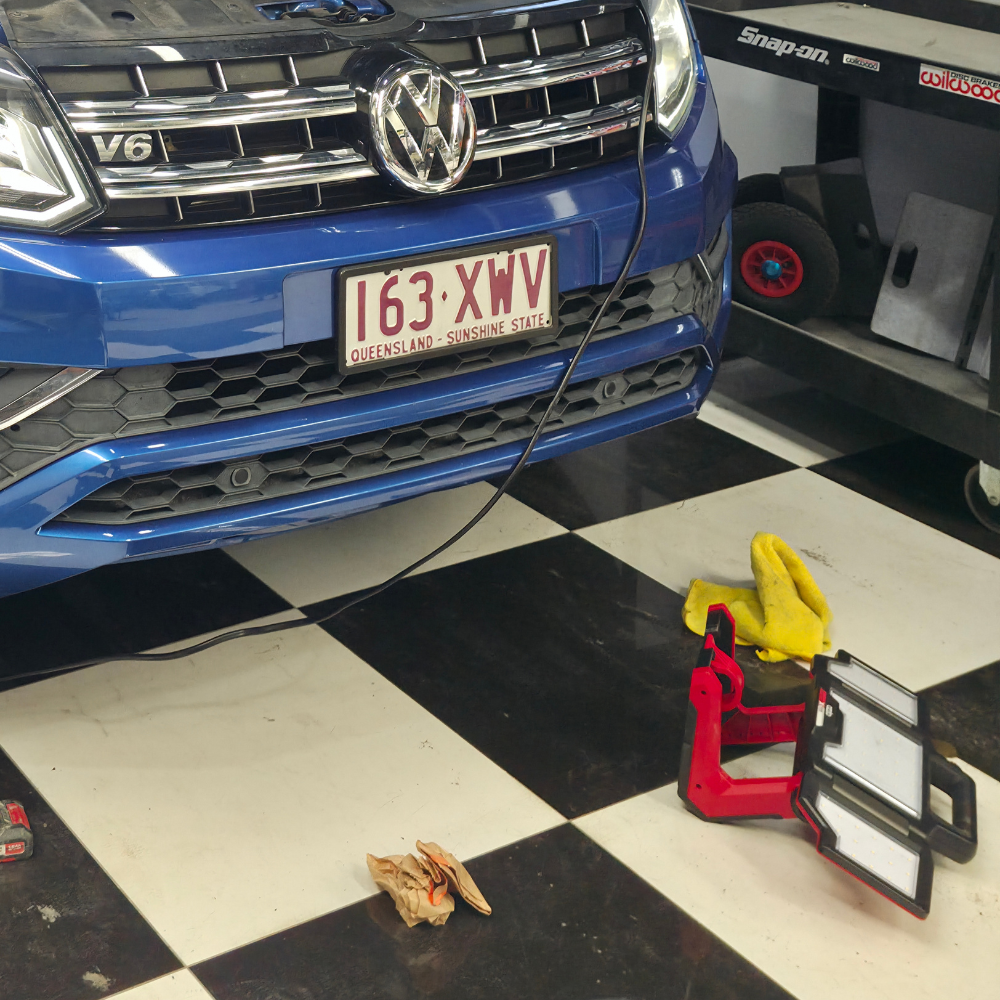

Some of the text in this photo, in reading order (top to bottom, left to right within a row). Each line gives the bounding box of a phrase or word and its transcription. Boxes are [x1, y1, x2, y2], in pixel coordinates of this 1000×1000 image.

[737, 26, 829, 64] Snap-on
[950, 71, 970, 82] DISC
[91, 132, 153, 163] V6
[351, 335, 433, 362] QUEENSLAND
[447, 320, 505, 345] SUNSHINE
[511, 313, 544, 331] STATE
